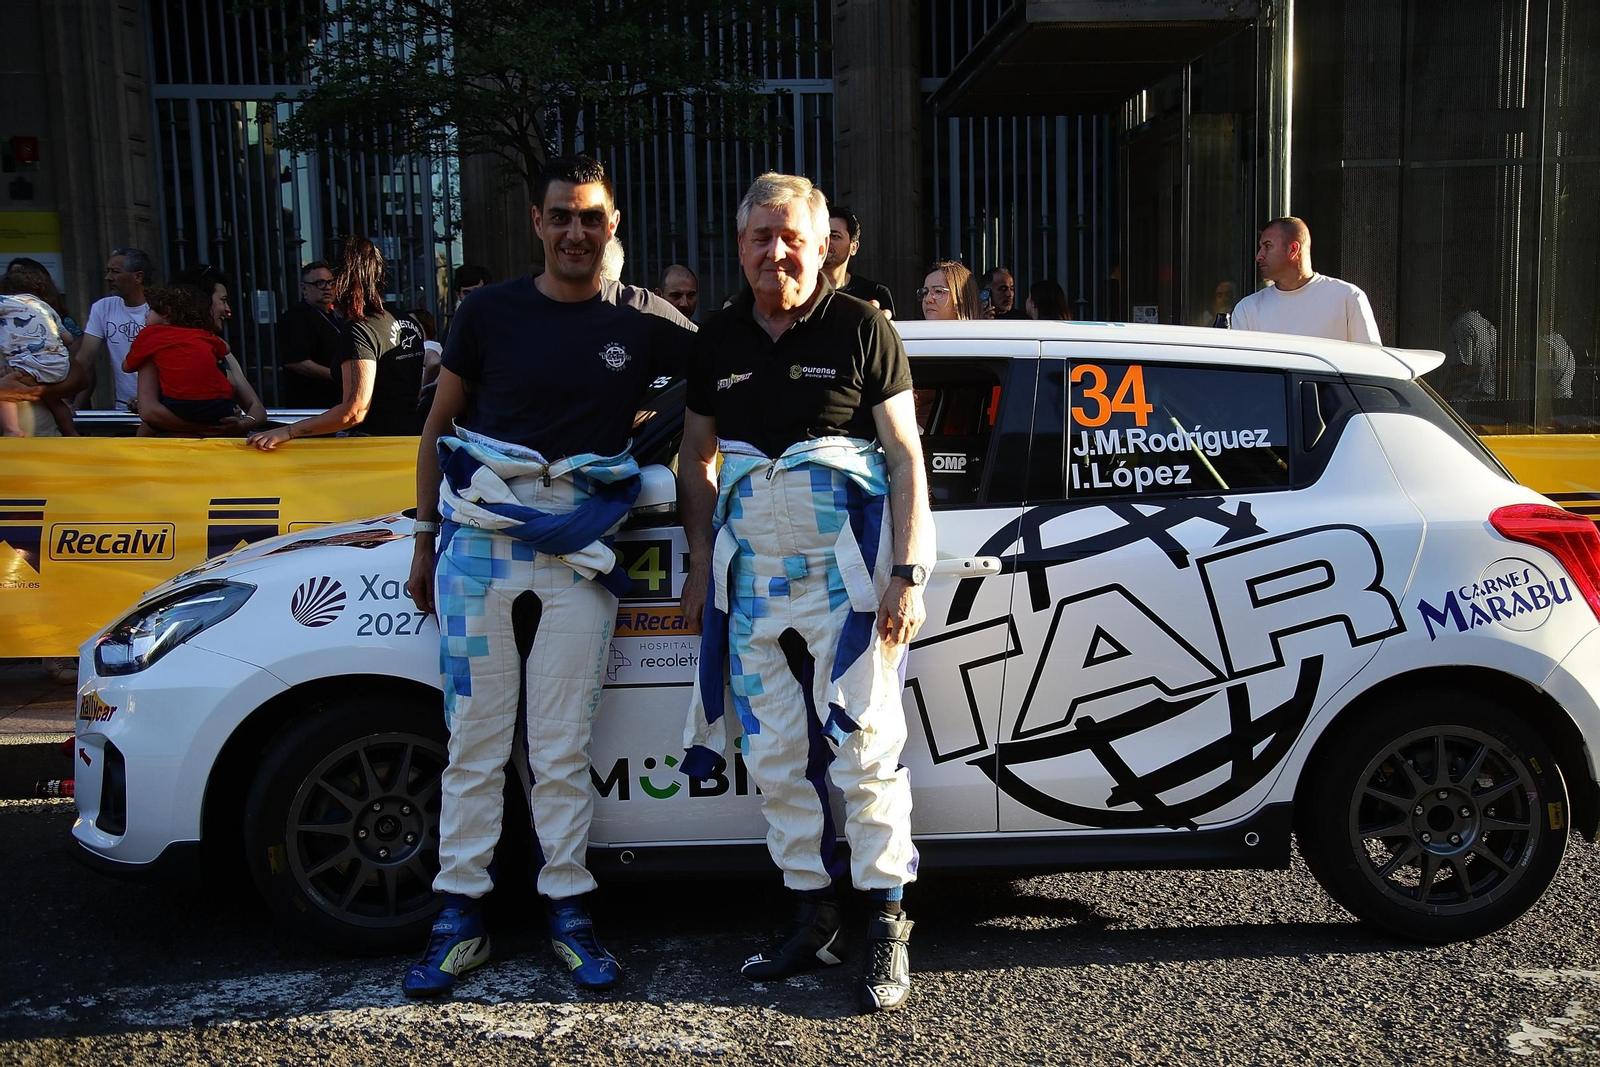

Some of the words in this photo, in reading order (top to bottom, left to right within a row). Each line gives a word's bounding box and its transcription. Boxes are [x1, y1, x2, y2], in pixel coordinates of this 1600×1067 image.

[802, 366, 836, 375] ourense
[1070, 364, 1153, 427] 34
[1073, 425, 1271, 457] J.M.Rodríguez
[932, 456, 967, 469] OMP
[1071, 460, 1191, 493] I.López
[56, 529, 168, 554] Recalvi
[1459, 568, 1530, 600] CARNES
[1417, 577, 1573, 642] MARABU
[357, 612, 429, 636] 2027
[640, 642, 694, 651] HOSPITAL
